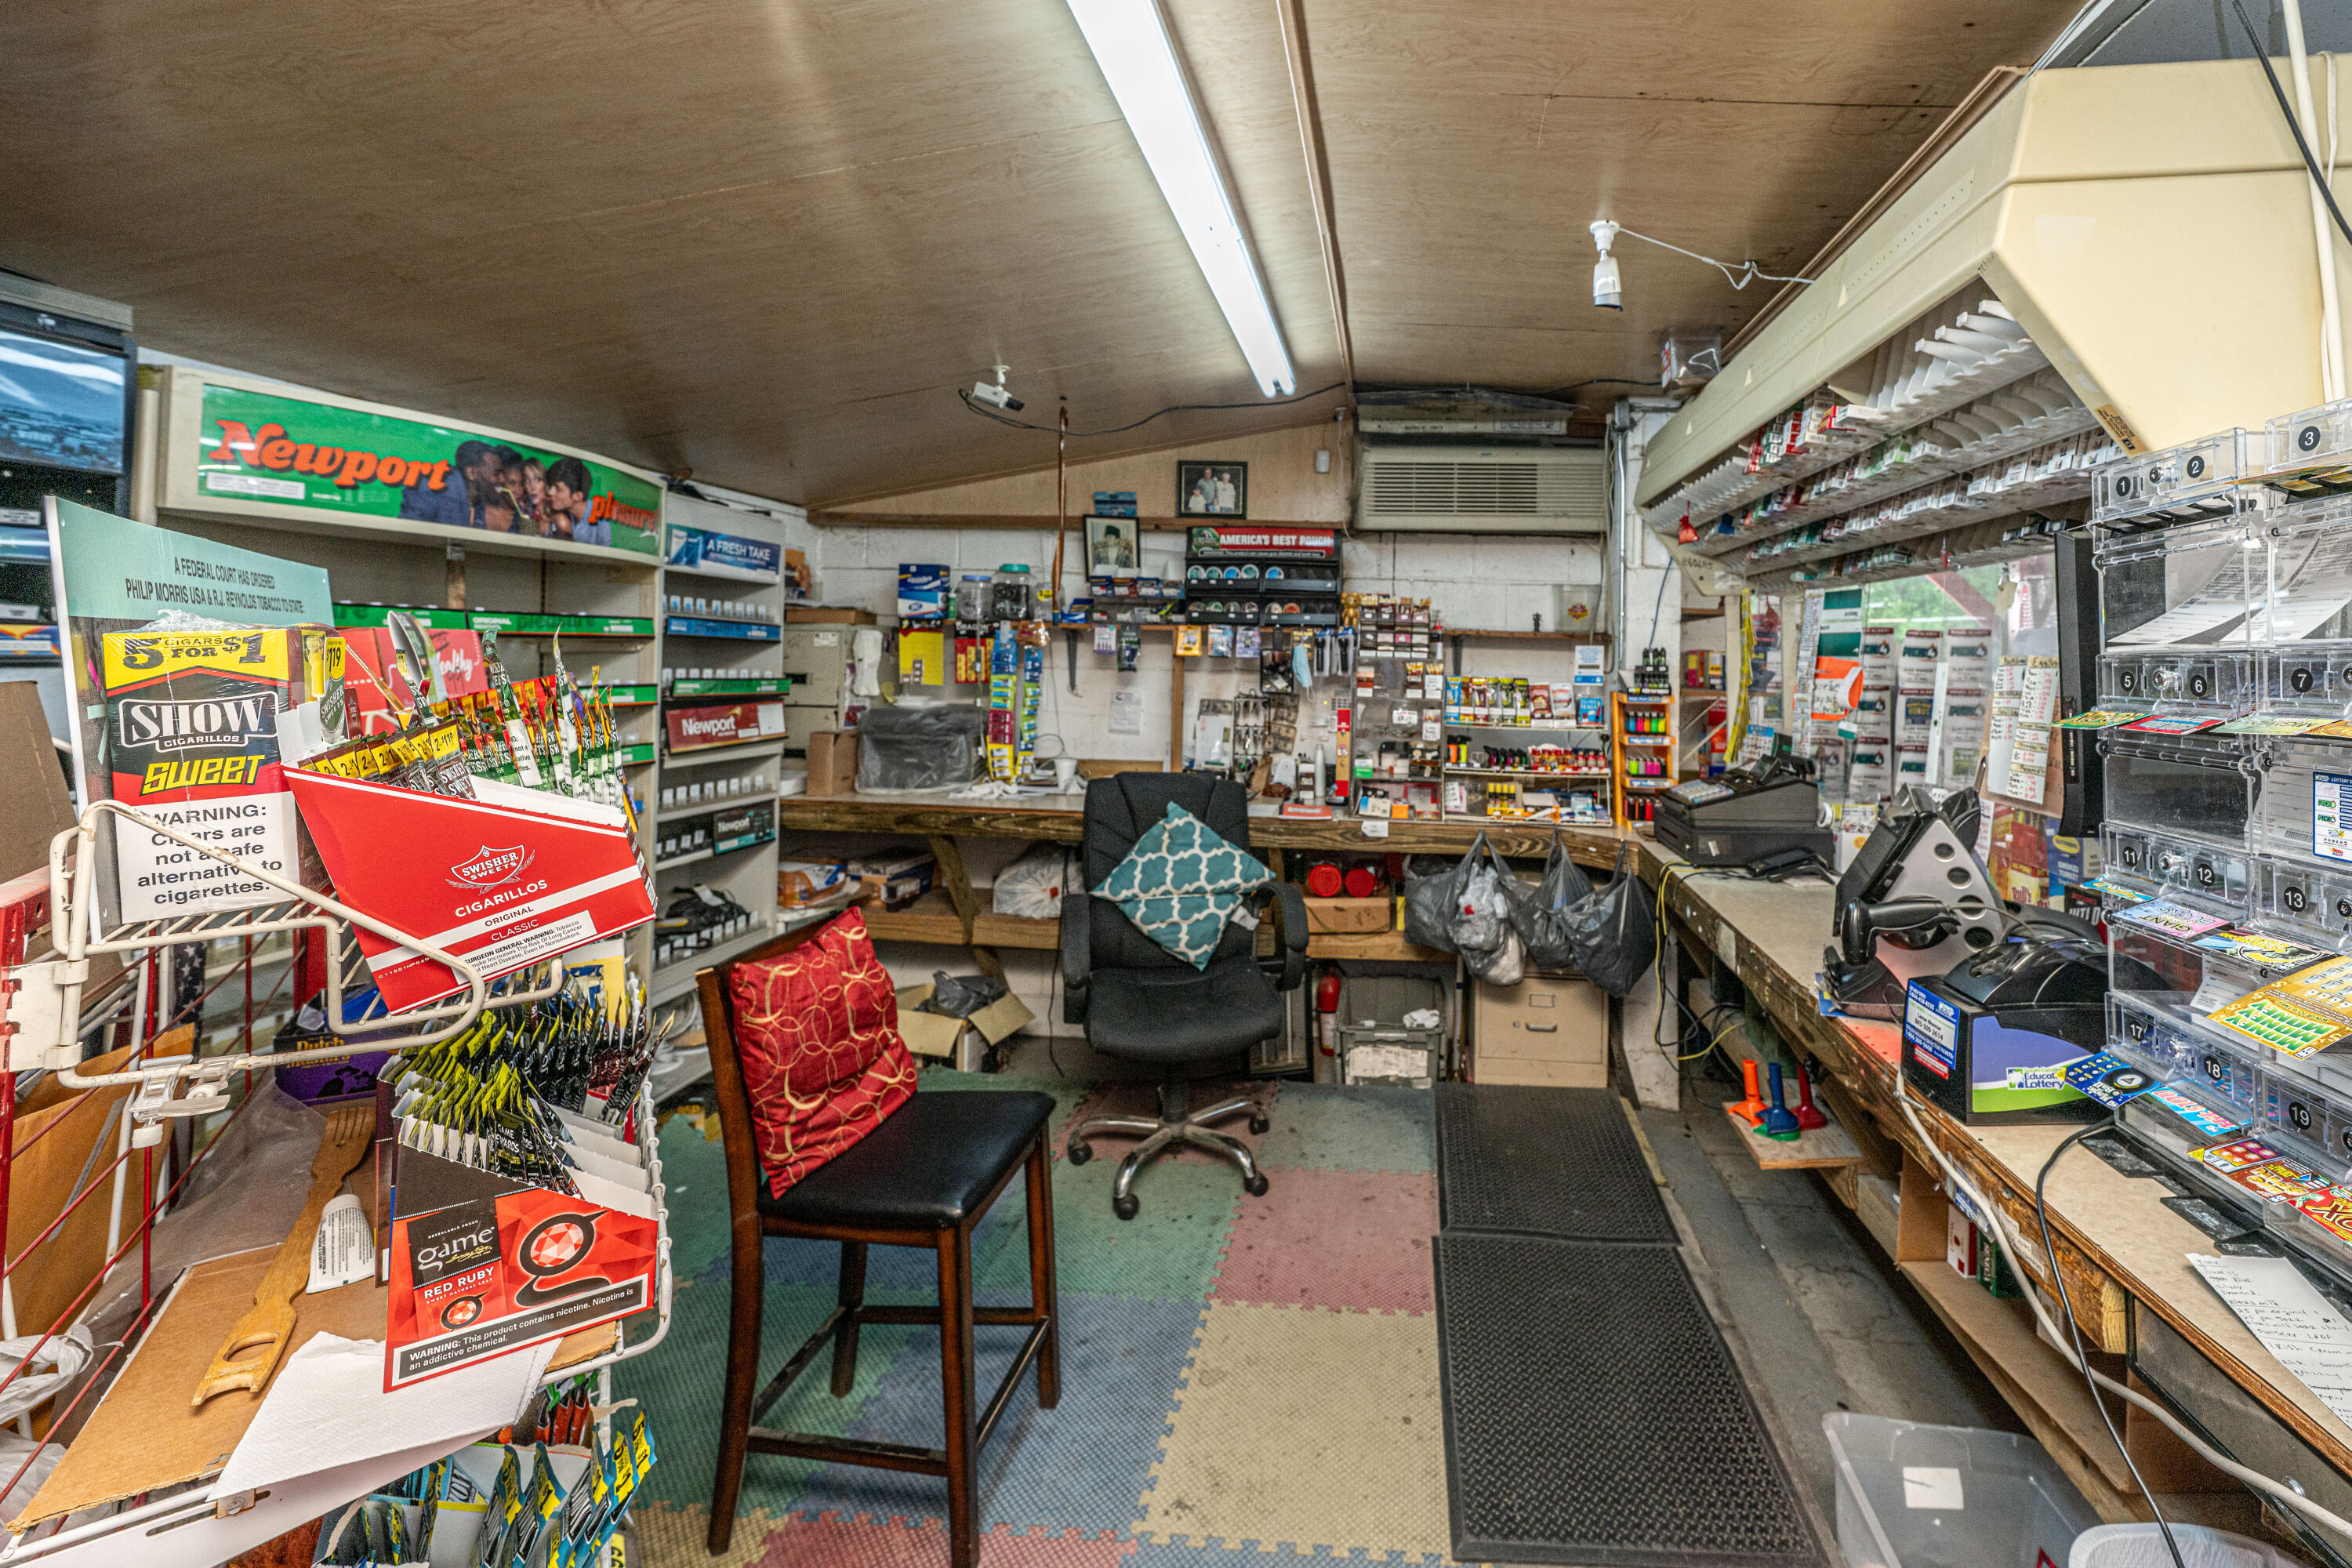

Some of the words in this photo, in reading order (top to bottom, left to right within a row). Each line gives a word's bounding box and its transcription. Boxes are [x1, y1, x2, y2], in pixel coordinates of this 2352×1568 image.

[2304, 430, 2314, 446] 3
[208, 419, 453, 492] Newport
[2191, 460, 2200, 474] 2
[2120, 481, 2126, 492] 1
[707, 539, 715, 550] A
[716, 539, 747, 556] FRESH
[748, 546, 771, 561] TAKE
[1220, 534, 1270, 546] AMERICA'S
[1272, 535, 1298, 546] BEST
[174, 557, 180, 575] A
[181, 557, 216, 580] FEDERAL
[215, 564, 237, 583] COURT
[237, 570, 250, 586] HAS
[250, 573, 275, 590] ORDERED
[125, 578, 153, 601] PHILIP
[155, 583, 189, 604] MORRIS
[190, 586, 206, 605] USA
[207, 589, 212, 605] &
[213, 589, 226, 607] R.J.
[226, 590, 257, 610] REYNOLDS
[257, 595, 282, 612] TOBACCO
[281, 597, 289, 612] TO
[165, 636, 222, 646] CIGARS
[222, 633, 266, 664] $1
[123, 636, 164, 670] 5
[171, 646, 218, 659] FOR
[2124, 676, 2131, 687] 5
[2194, 679, 2203, 692] 6
[2297, 673, 2307, 688] 7
[321, 684, 344, 719] SWISHER
[324, 698, 344, 725] SWEETS
[131, 697, 264, 742] SHOW
[681, 717, 735, 737] Newport
[164, 735, 240, 748] CIGARILLOS
[434, 739, 441, 752] 2
[140, 755, 265, 796] SWEET
[154, 804, 267, 825] WARNING:
[717, 816, 750, 834] Newport
[231, 825, 266, 838] are
[155, 850, 192, 866] not
[223, 842, 264, 856] afe
[462, 851, 519, 877] SWISHER
[2124, 850, 2136, 863] 11
[138, 865, 241, 887] alternativ
[261, 860, 283, 871] to
[470, 861, 517, 880] SWEETS
[2198, 868, 2212, 883] 12
[154, 880, 270, 905] cigarettes.
[455, 880, 548, 917] CIGARILLOS
[2285, 891, 2303, 907] 13
[485, 906, 535, 927] ORIGINAL
[2138, 915, 2191, 932] GIANT
[491, 919, 539, 941] CLASSIC
[464, 950, 495, 964] SURGEON
[495, 940, 524, 953] GENERAL
[523, 929, 555, 943] WARNING:
[555, 920, 579, 931] Tobacco
[481, 961, 498, 971] Heart
[499, 953, 524, 965] Disease,
[524, 947, 538, 956] Even
[545, 931, 580, 946] Nonsmokers.
[487, 949, 517, 962] Increases
[549, 931, 563, 942] Lung
[562, 925, 583, 935] Cancer
[2237, 1007, 2321, 1043] MONEY
[2250, 1000, 2337, 1034] MONEY
[2130, 1023, 2143, 1039] 17
[2226, 1014, 2307, 1051] MONEY
[2024, 1072, 2058, 1080] Educat
[2205, 1058, 2221, 1078] 18
[2024, 1080, 2064, 1090] Lottery
[2291, 1108, 2310, 1126] 19
[496, 1124, 514, 1139] GAME
[495, 1134, 520, 1153] EWARDS
[427, 1225, 460, 1240] RESEALABLE
[461, 1219, 479, 1229] POUCH
[417, 1229, 493, 1272] game
[424, 1282, 453, 1299] RED
[457, 1266, 495, 1287] RUBY
[426, 1294, 448, 1305] SWEET
[449, 1283, 477, 1297] NATURAL
[478, 1277, 493, 1286] LEAF
[409, 1339, 461, 1362] WARNING:
[463, 1334, 481, 1346] This
[483, 1323, 517, 1342] product
[518, 1313, 555, 1330] contains
[556, 1304, 590, 1319] nicotine.
[592, 1294, 625, 1308] Nicotine
[626, 1287, 633, 1296] is
[409, 1362, 421, 1370] an
[423, 1347, 464, 1366] addictive
[466, 1334, 508, 1354] chemical.
